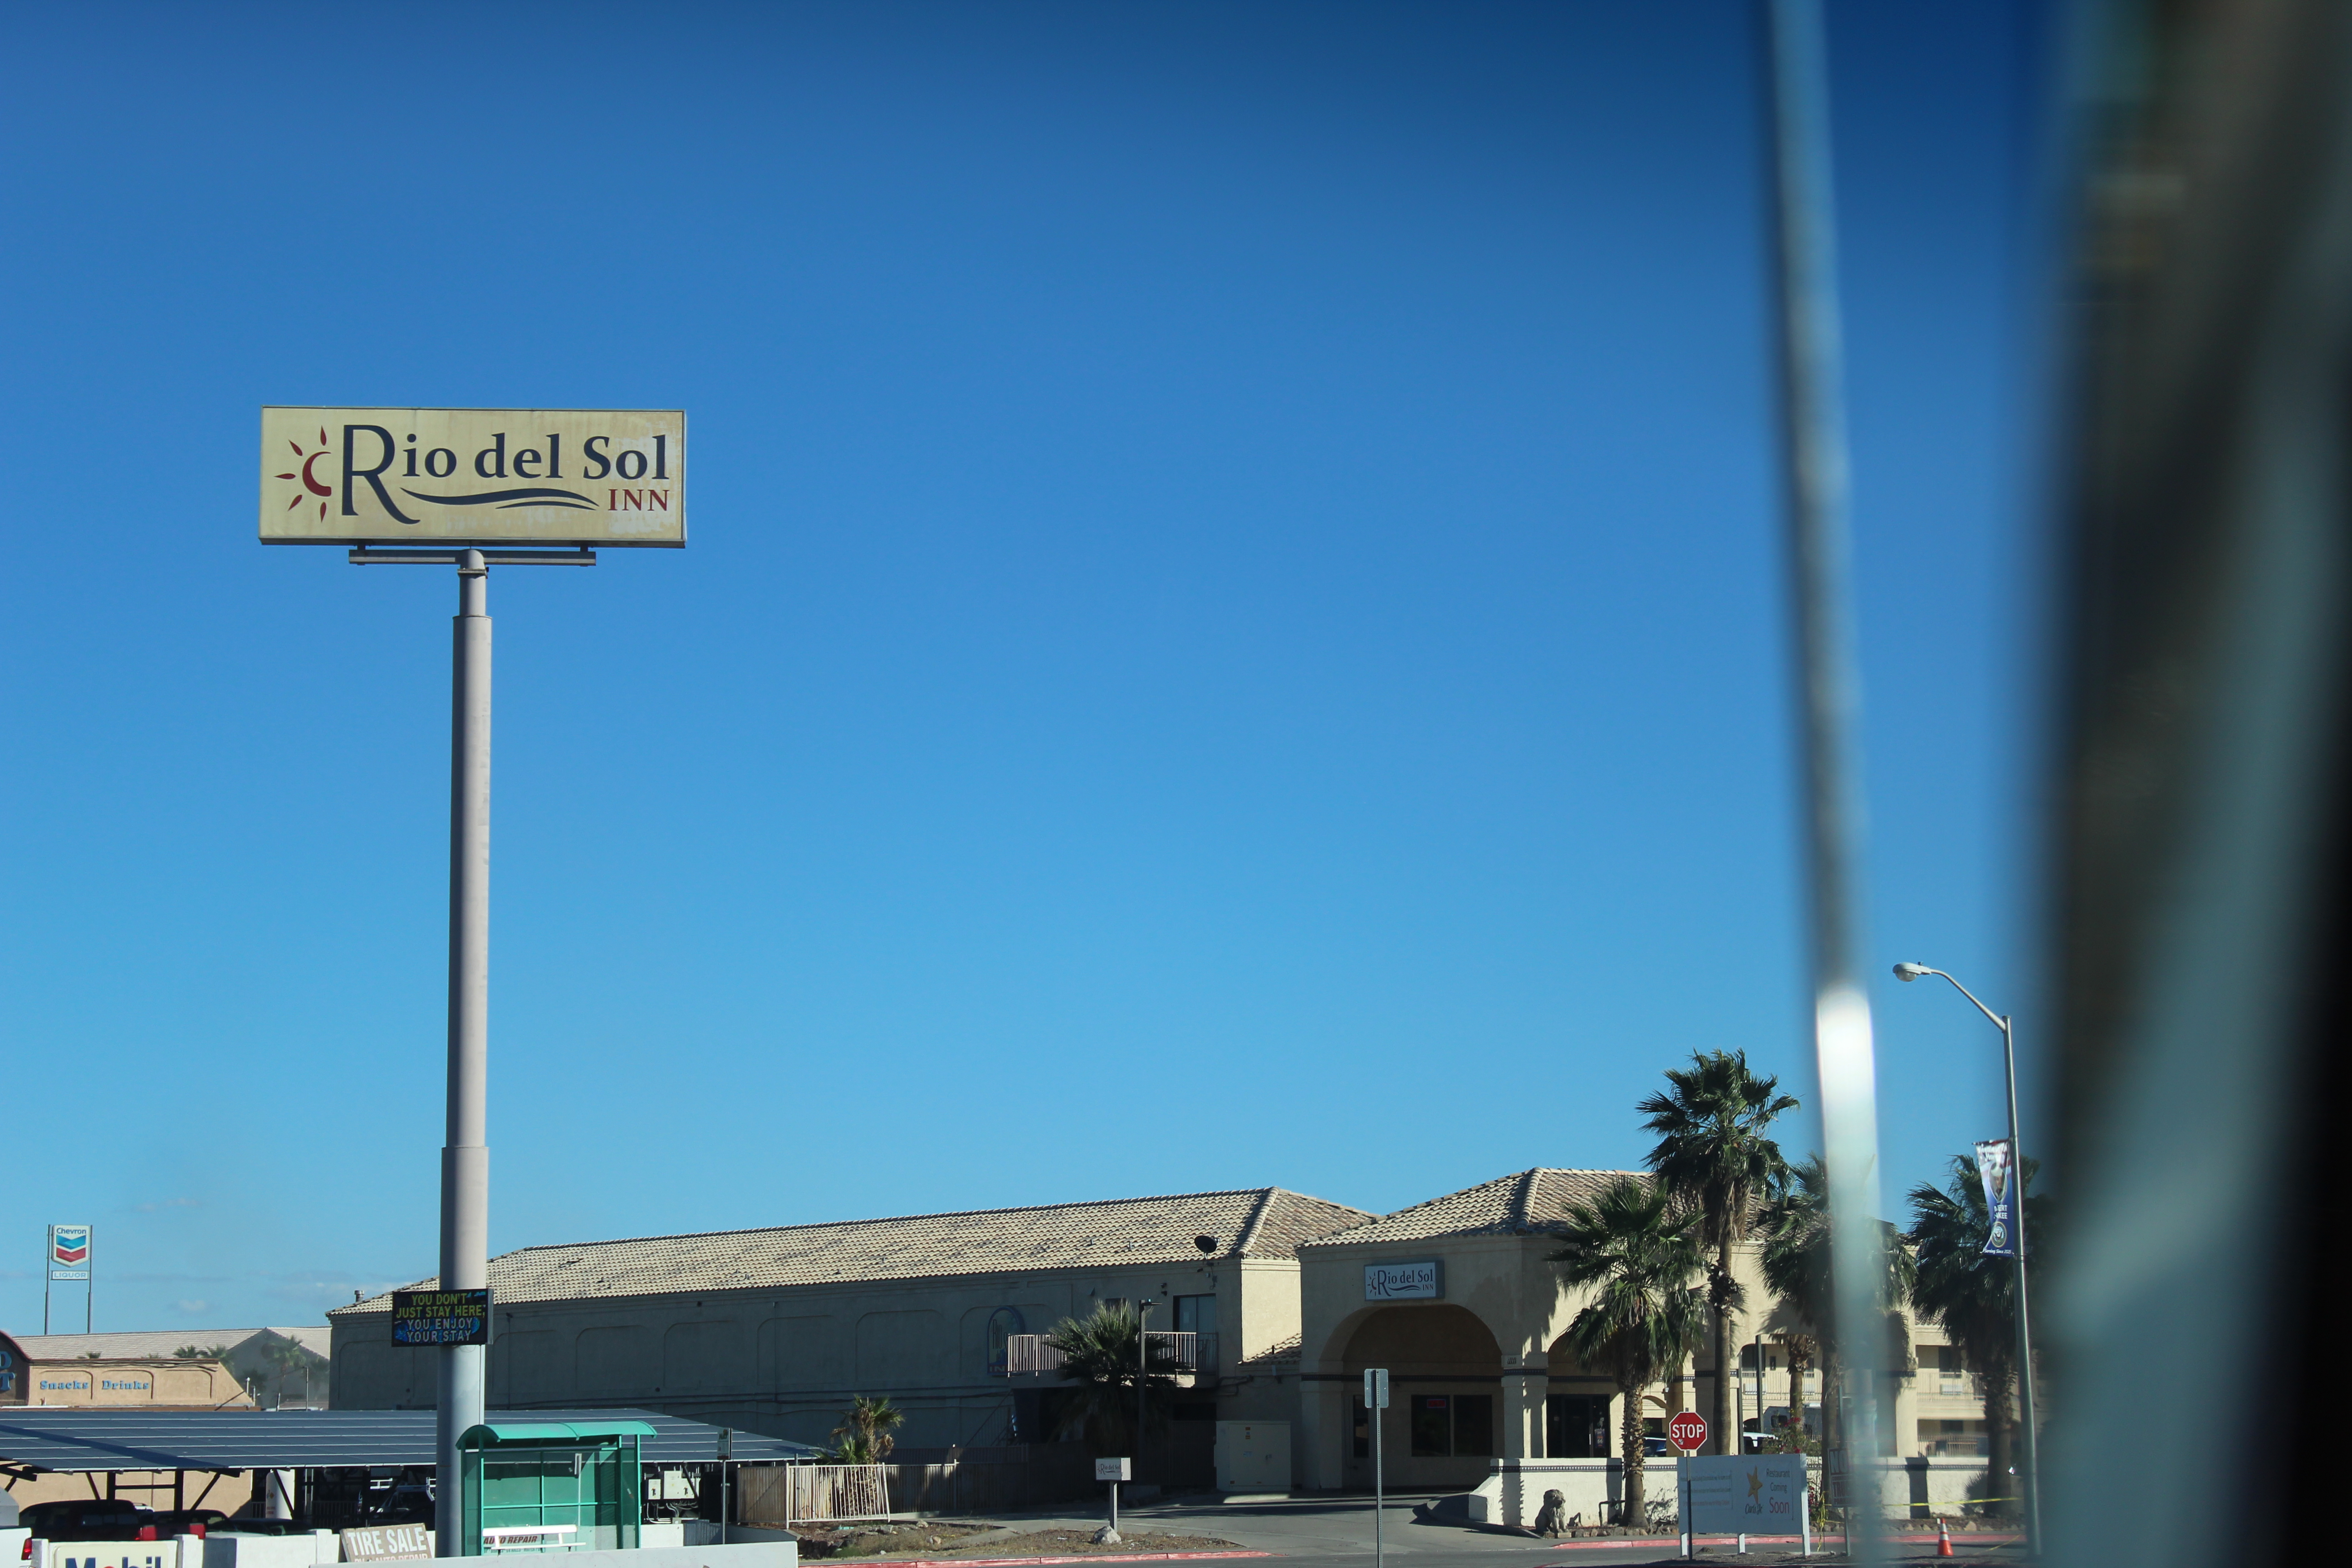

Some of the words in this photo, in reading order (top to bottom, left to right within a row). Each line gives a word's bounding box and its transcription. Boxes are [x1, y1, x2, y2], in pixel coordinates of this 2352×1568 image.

[342, 425, 457, 524] Rio
[474, 433, 564, 478] del
[583, 434, 670, 480] Sol
[608, 489, 668, 511] INN
[1377, 1270, 1397, 1297] Rio
[1400, 1270, 1415, 1283] del
[1418, 1269, 1433, 1283] Sol
[412, 1294, 432, 1306] YOU
[436, 1293, 467, 1305] DON'T
[396, 1307, 422, 1318] JUST
[426, 1306, 451, 1317] STAY
[455, 1305, 485, 1318] HERE,
[407, 1319, 430, 1330] YOU
[435, 1318, 473, 1329] ENJOY
[407, 1331, 437, 1343] YOUR
[443, 1330, 471, 1341] STAY
[40, 1380, 89, 1390] Snacks
[102, 1380, 149, 1390] Drinks
[1672, 1424, 1704, 1438] STOP
[1766, 1468, 1790, 1478] Restaurant
[1770, 1482, 1787, 1494] Coming
[1769, 1497, 1789, 1514] Soon
[347, 1530, 384, 1556] TIRE
[386, 1527, 427, 1554] SALE
[484, 1536, 506, 1545] AUO
[507, 1535, 538, 1544] REPAIR
